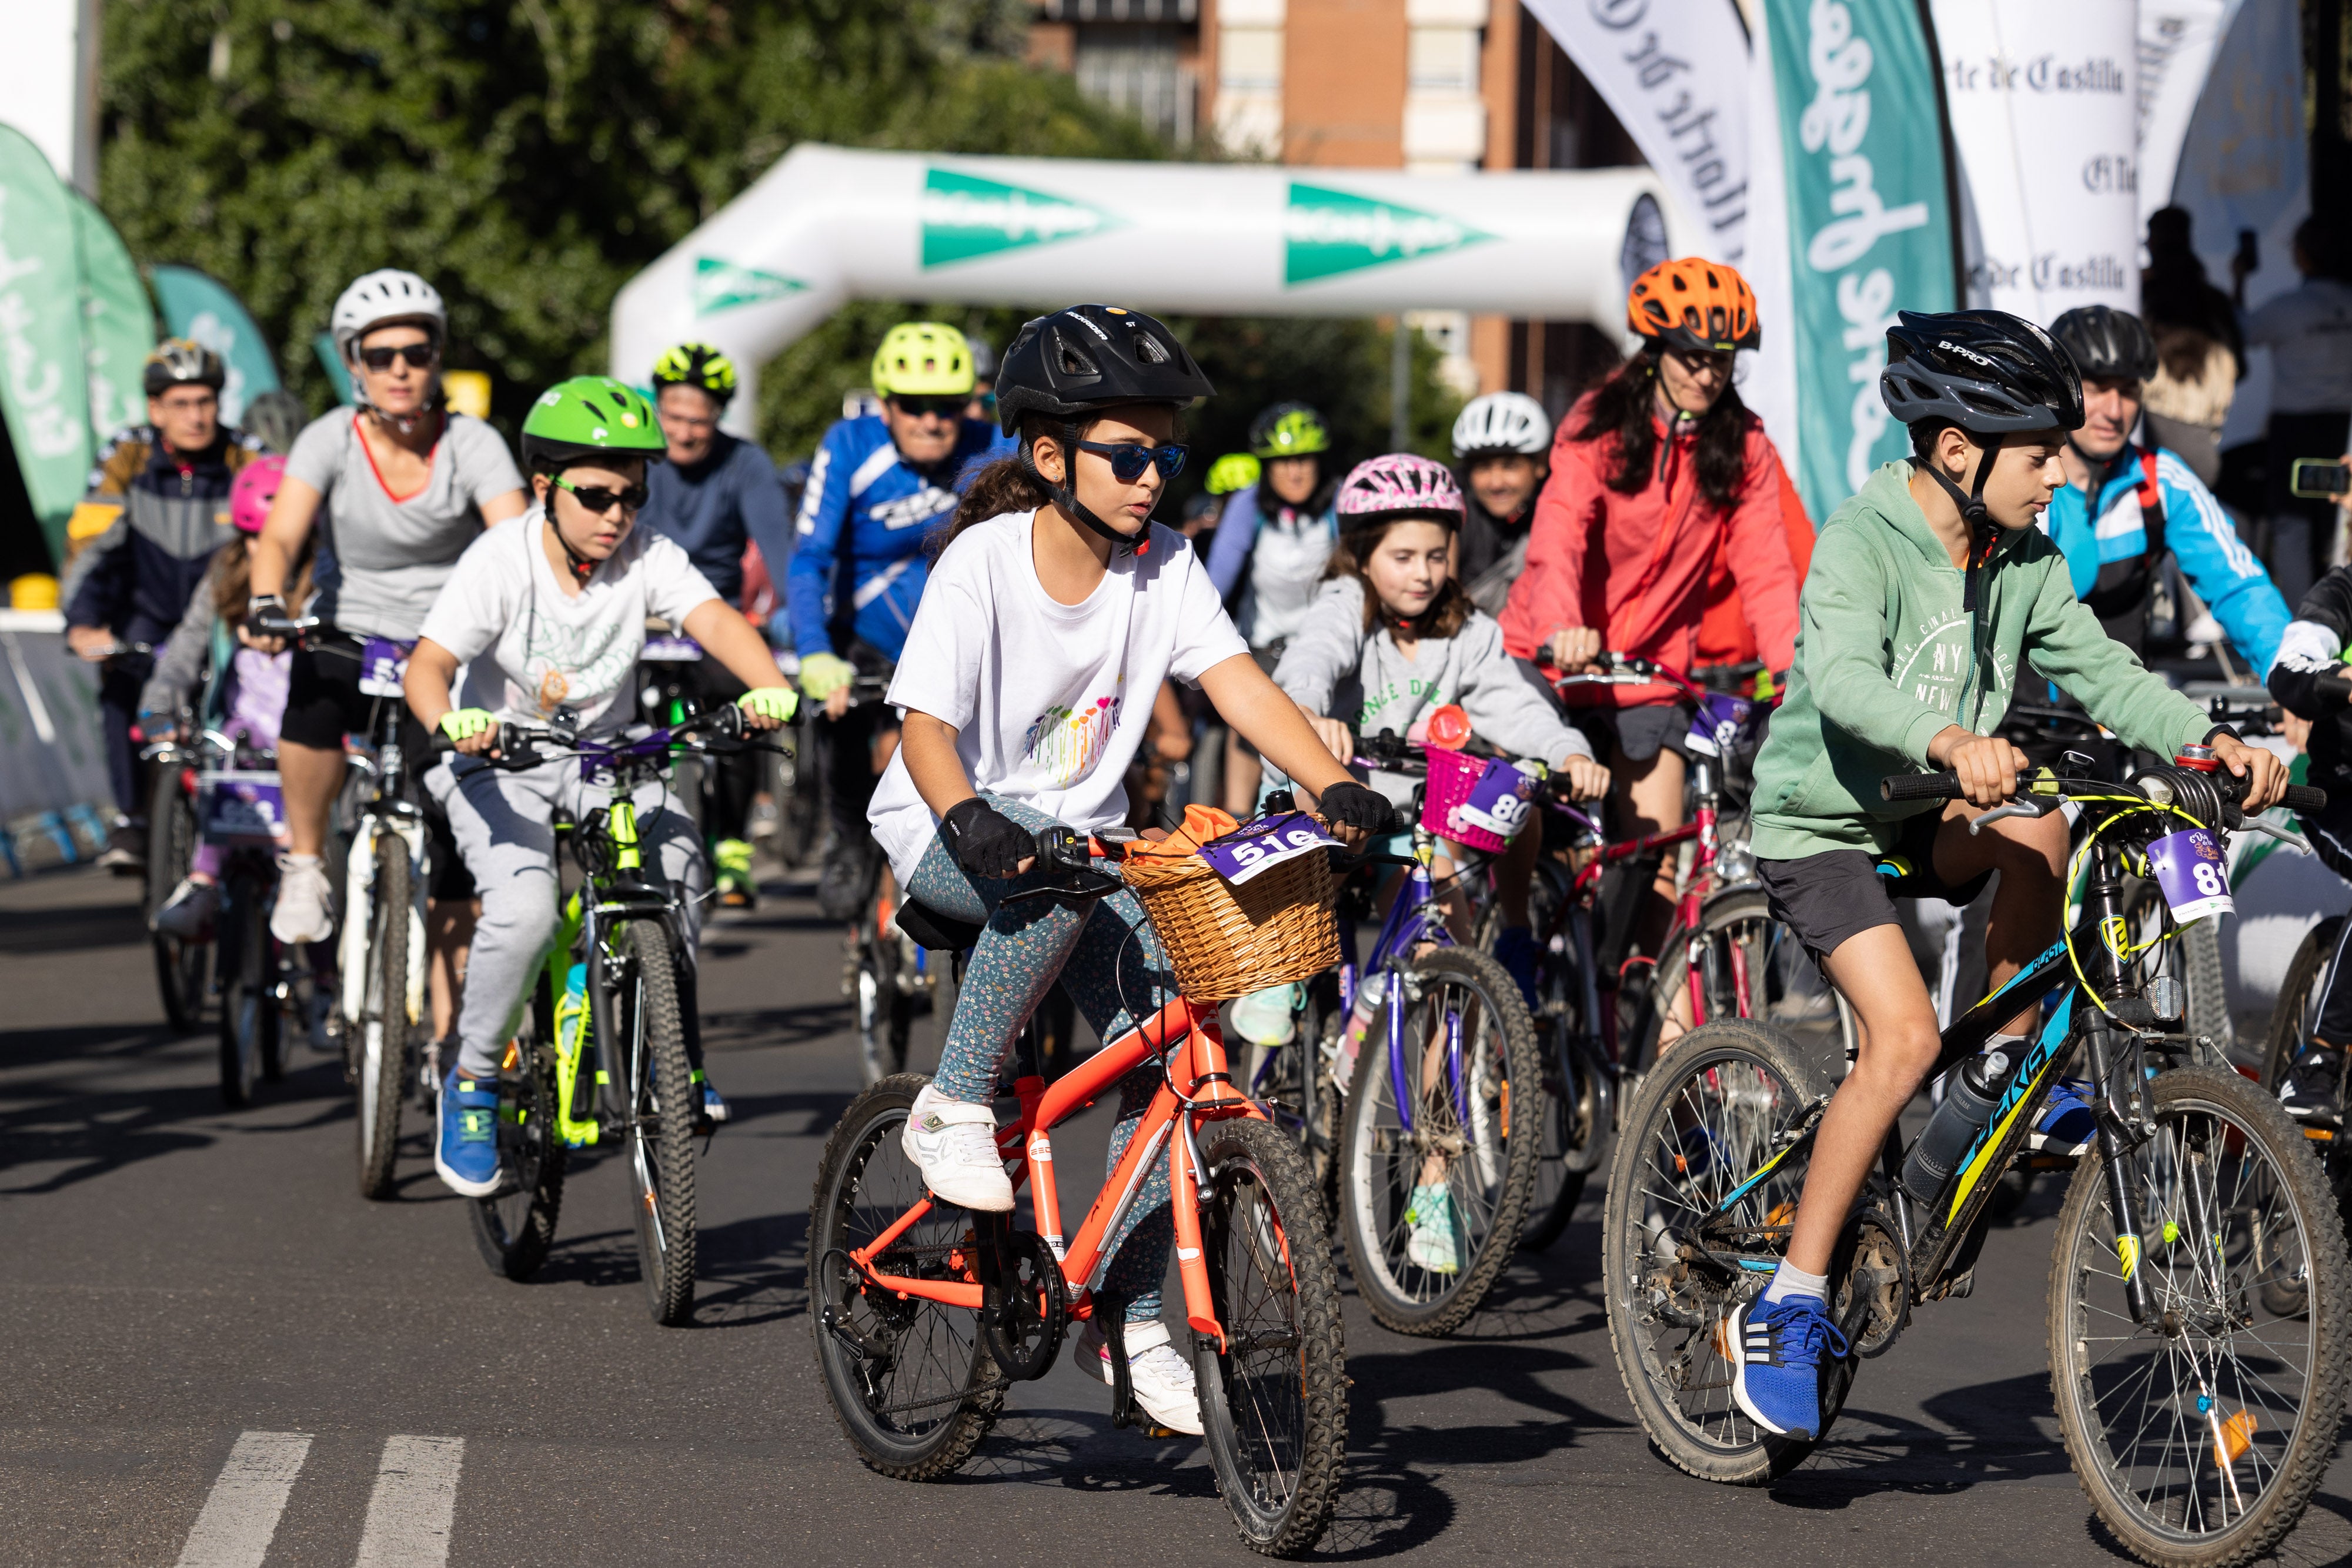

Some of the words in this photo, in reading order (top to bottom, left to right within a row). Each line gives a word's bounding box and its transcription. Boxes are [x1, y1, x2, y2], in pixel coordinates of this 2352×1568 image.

[1065, 311, 1108, 340] ROCKRIDER
[1937, 339, 1989, 366] B-PRO
[1933, 643, 1963, 674] NY
[1231, 830, 1319, 866] 516
[1953, 1090, 1972, 1111] CAMELBAK
[841, 1339, 860, 1356] SHIMANO
